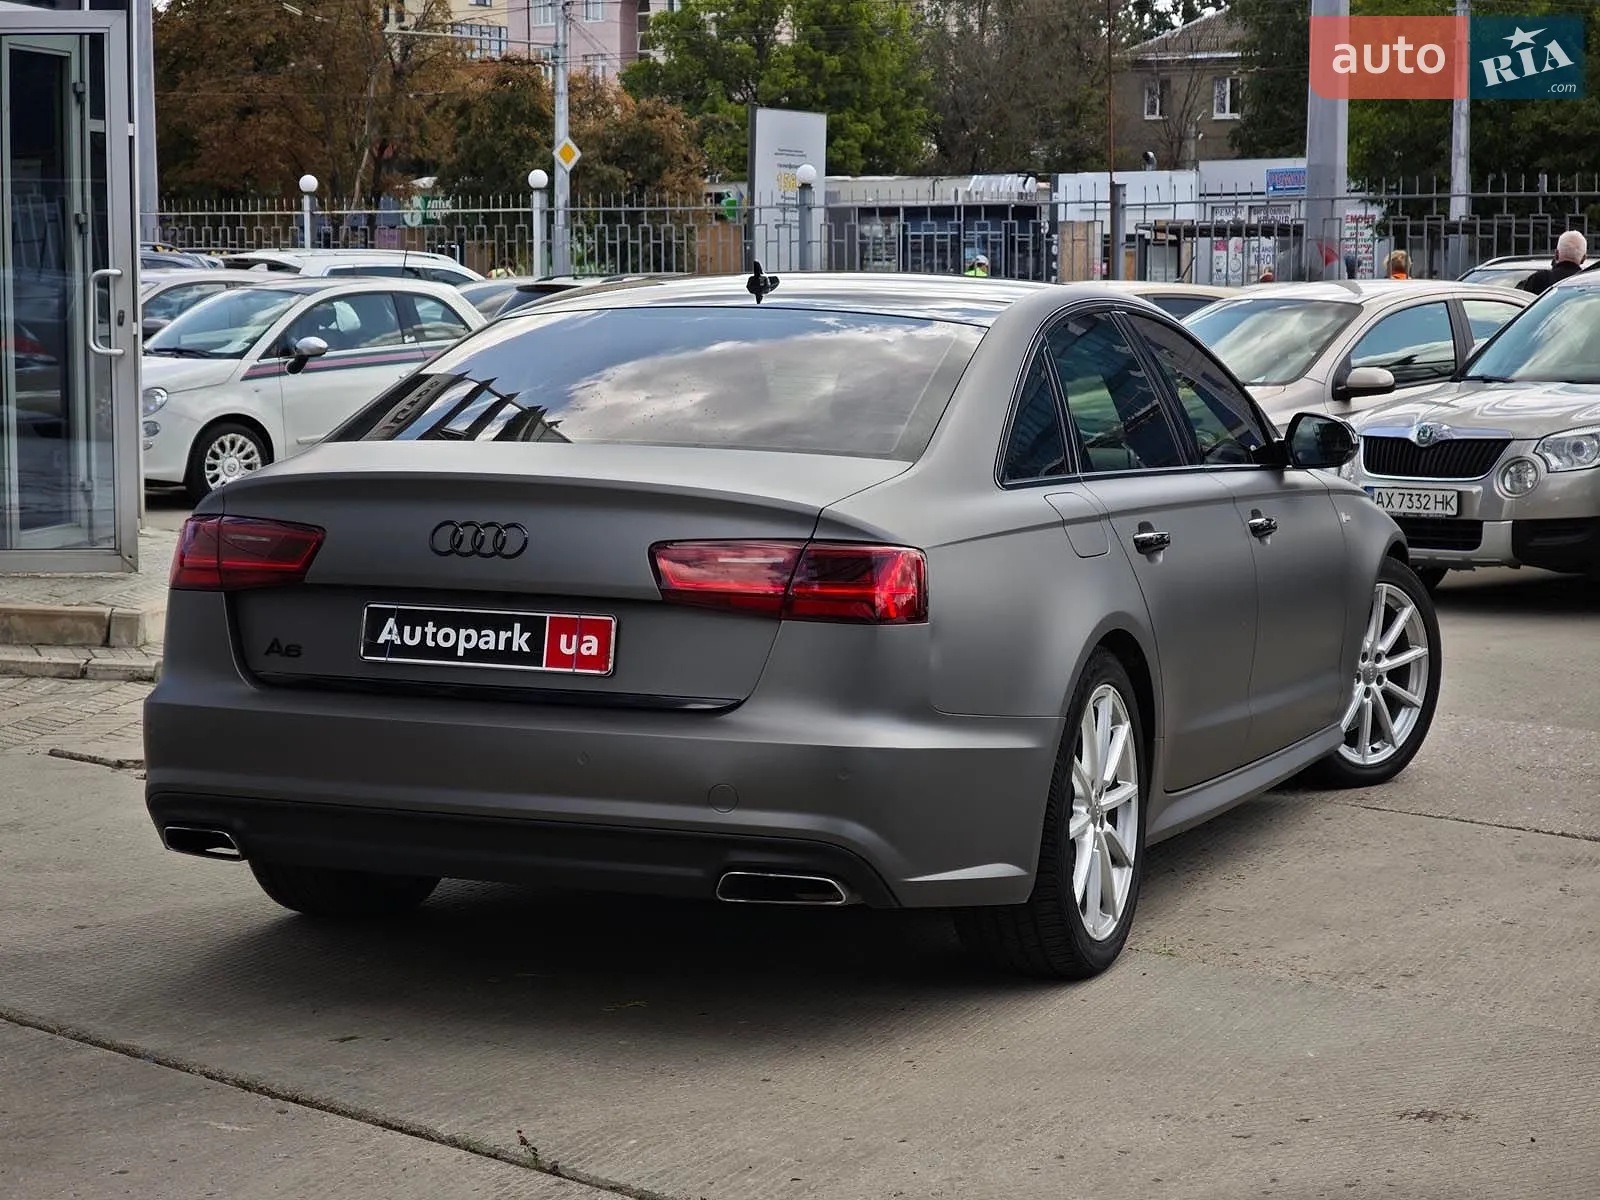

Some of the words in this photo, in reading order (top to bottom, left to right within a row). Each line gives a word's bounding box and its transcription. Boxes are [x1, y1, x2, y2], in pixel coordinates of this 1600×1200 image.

[1376, 491, 1396, 509] AX
[1398, 492, 1431, 510] 7332
[1435, 494, 1456, 512] HK
[264, 638, 304, 658] A6
[377, 618, 531, 657] Autopark
[559, 632, 599, 657] ua
